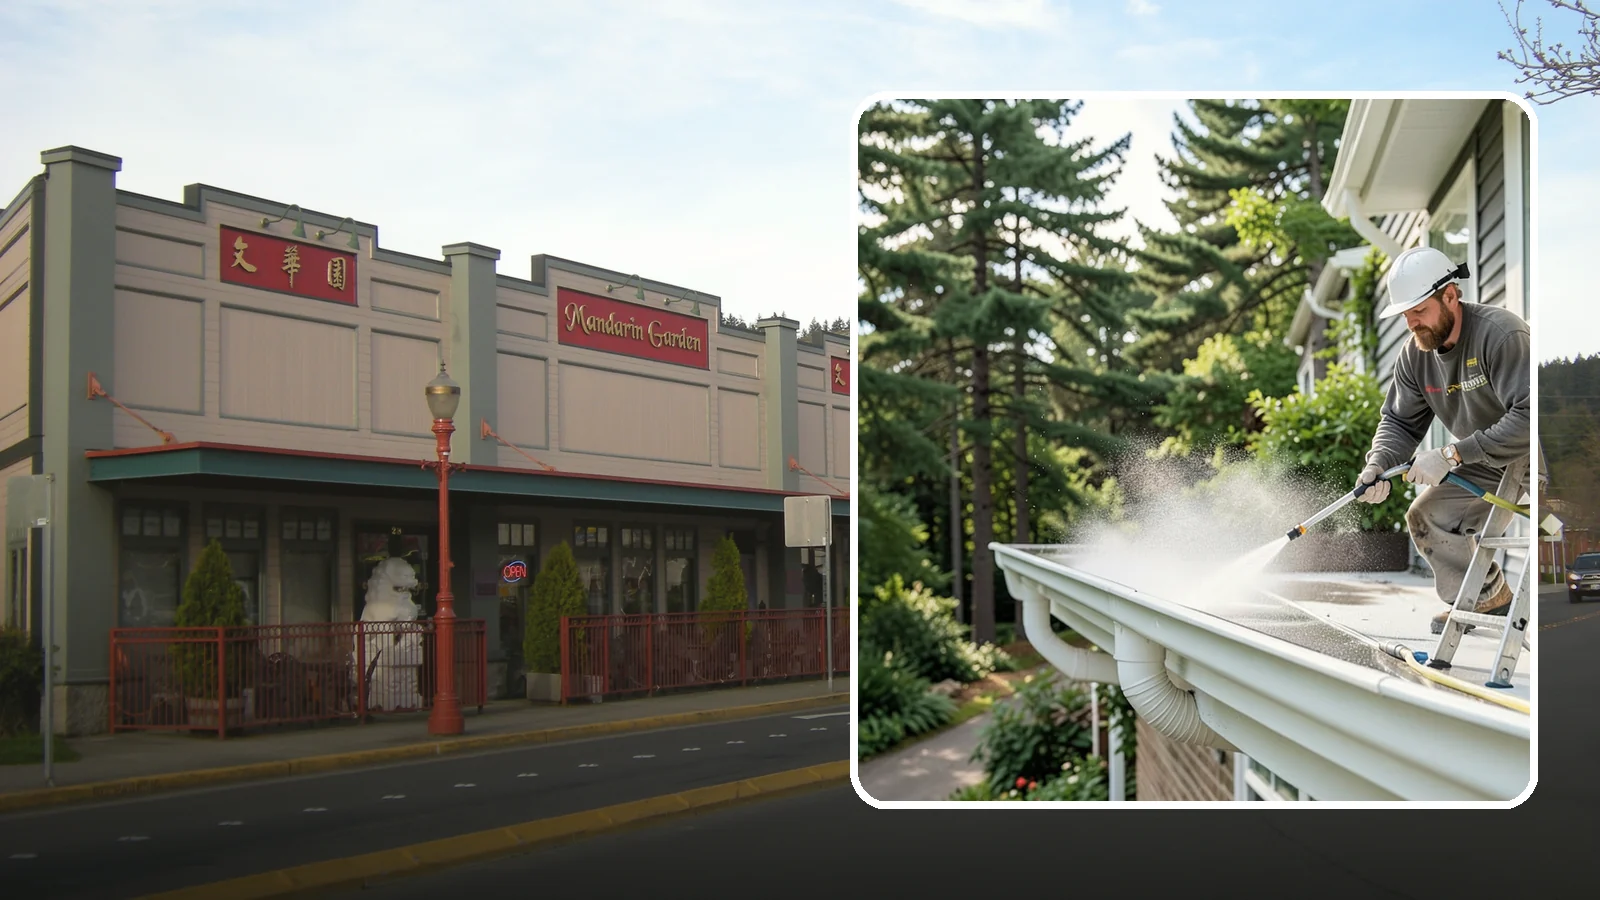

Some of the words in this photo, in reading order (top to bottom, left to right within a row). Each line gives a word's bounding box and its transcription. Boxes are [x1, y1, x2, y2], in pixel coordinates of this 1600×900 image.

[230, 235, 346, 290] 文華園
[564, 302, 644, 341] Mandarin
[647, 320, 702, 352] Garden
[503, 565, 527, 578] OPEN
